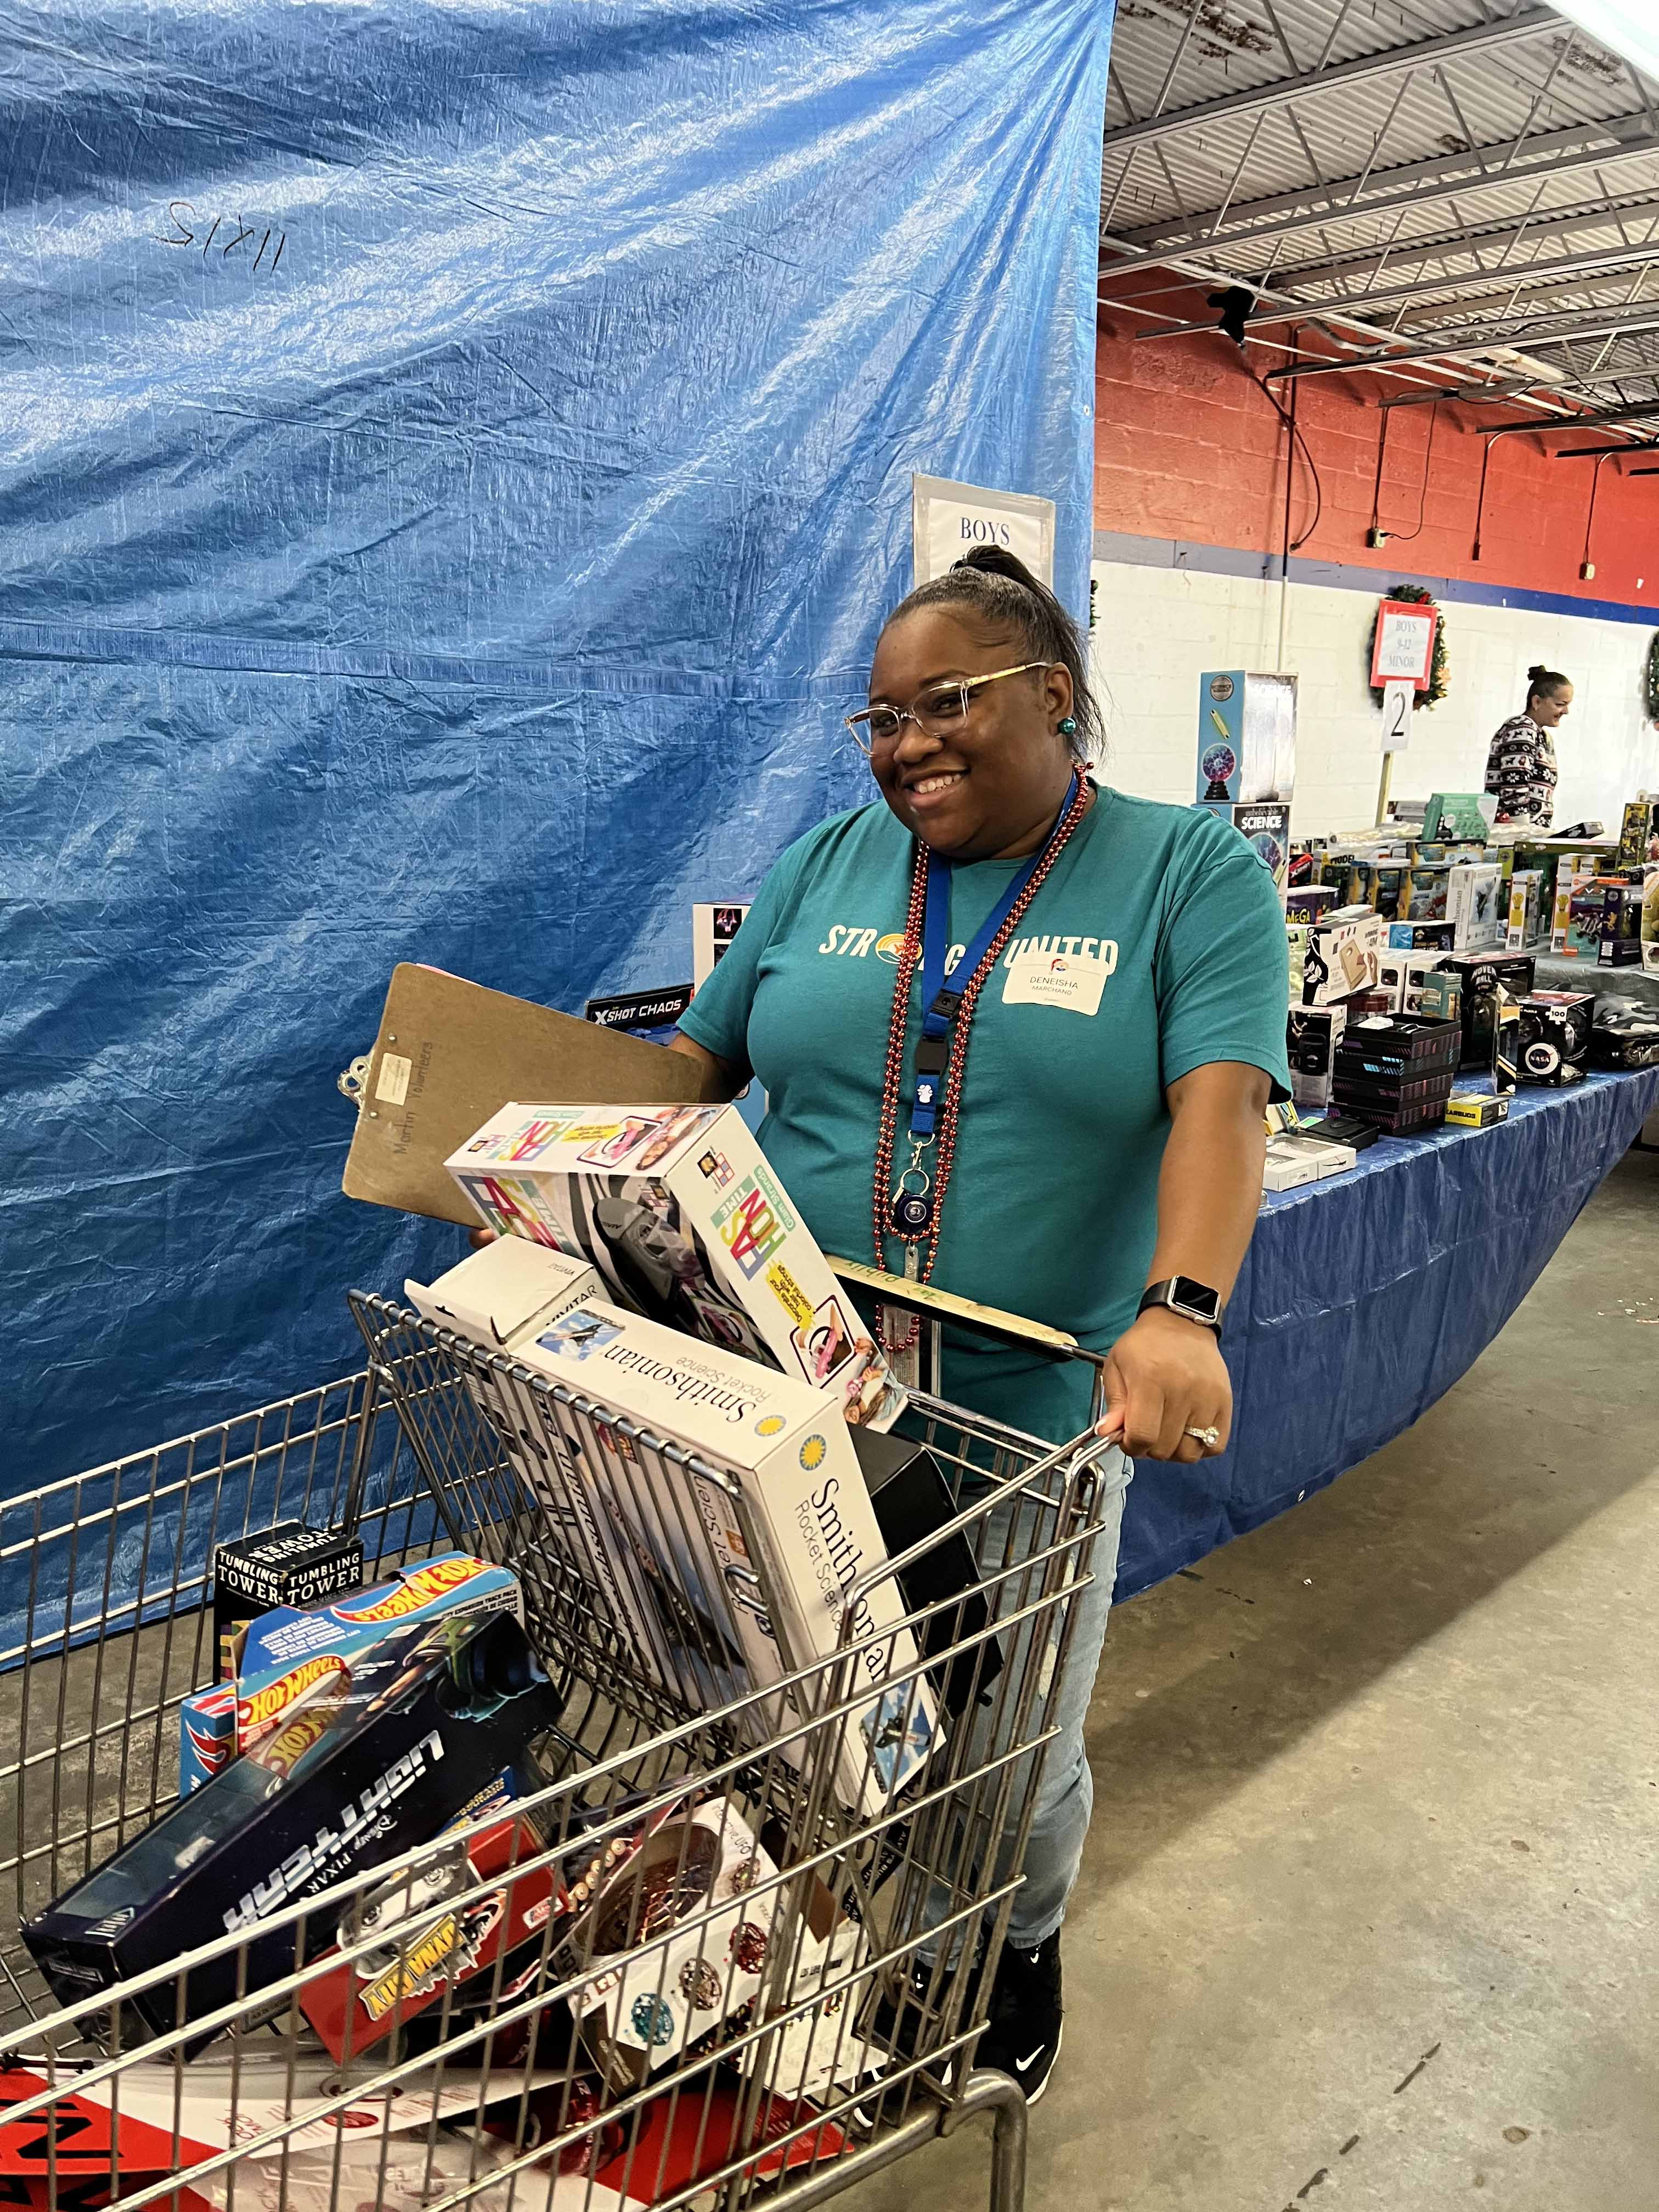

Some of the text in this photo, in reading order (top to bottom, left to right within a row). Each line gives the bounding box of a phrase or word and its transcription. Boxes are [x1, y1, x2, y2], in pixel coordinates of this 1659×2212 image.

[961, 517, 1010, 545] BOYS
[1396, 620, 1417, 632] BOYS
[1391, 692, 1406, 736] 2
[1241, 816, 1282, 830] SCIENCE
[1286, 908, 1310, 924] MEGA
[1030, 976, 1079, 989] DENEISHA
[1032, 985, 1072, 995] MARCHAND
[639, 999, 682, 1017] CHAOS
[393, 1112, 416, 1154] Martin
[410, 1042, 433, 1100] Volunteers
[721, 1187, 748, 1216] TIME
[754, 1167, 796, 1229] Glam Strands
[769, 1277, 784, 1294] your
[792, 1285, 812, 1312] colorful
[546, 1284, 599, 1327] VITAR
[604, 1345, 758, 1423] Smithsonian
[675, 1356, 773, 1403] Rocket Science
[248, 1531, 329, 1559] TOWER
[261, 1534, 338, 1563] TUMBLING
[219, 1551, 279, 1584] TUMBLING
[289, 1553, 359, 1588] TUMBLING
[795, 1499, 844, 1633] Rocket Science
[811, 1477, 889, 1683] Smithonan
[218, 1565, 279, 1605] TOWER
[287, 1566, 359, 1605] TOWER
[486, 1594, 501, 1604] TRACK
[307, 1814, 399, 1894] Disney PIXAR
[732, 1835, 753, 1857] UFO
